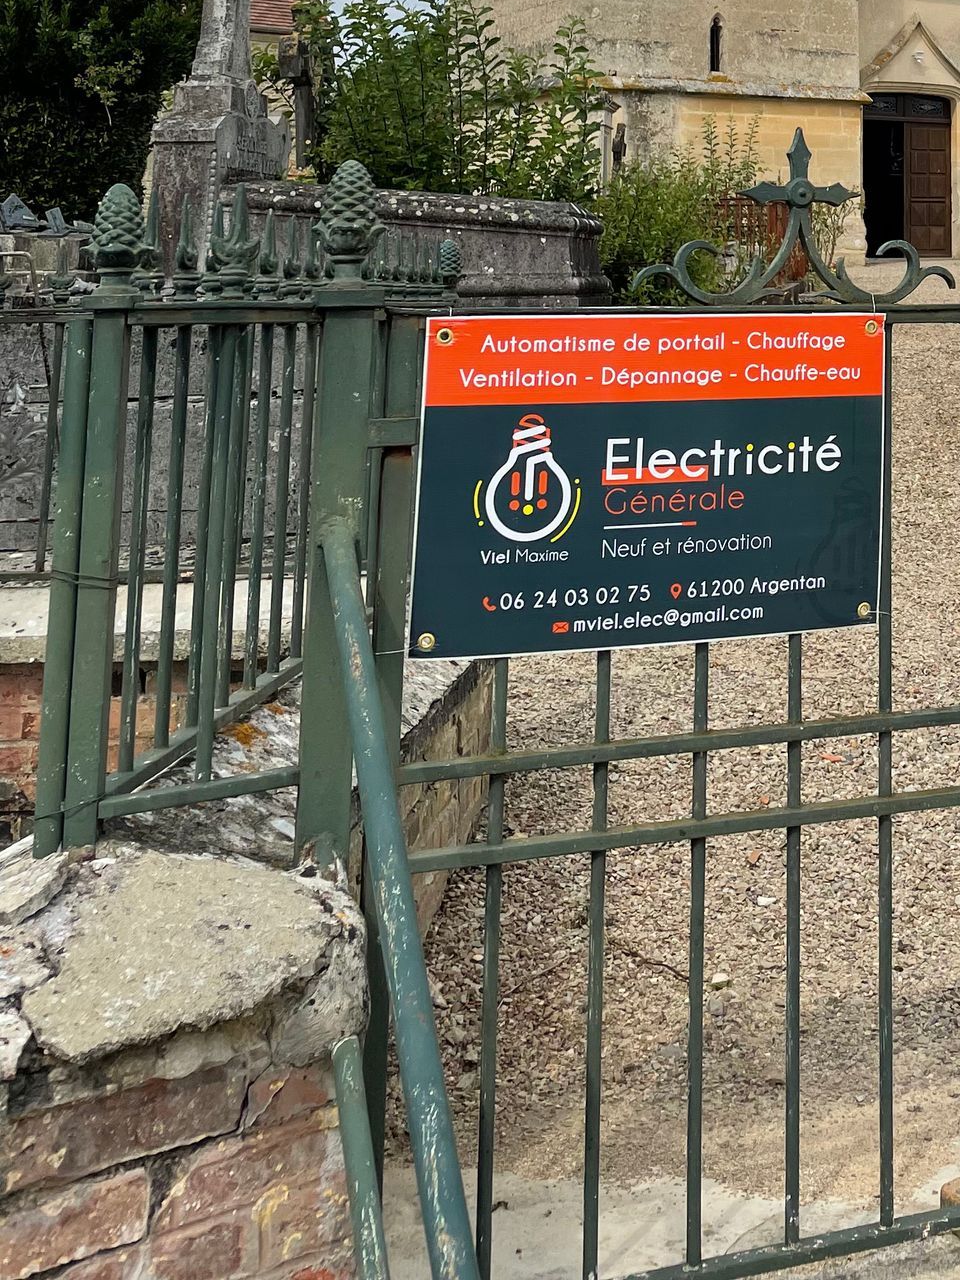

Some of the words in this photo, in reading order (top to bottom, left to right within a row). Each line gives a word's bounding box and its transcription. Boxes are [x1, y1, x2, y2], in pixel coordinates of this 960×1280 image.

[480, 334, 616, 353] Automatisme
[623, 333, 651, 352] de
[658, 332, 725, 354] portail
[747, 331, 846, 351] Chauffage
[459, 367, 577, 388] Ventilation
[601, 366, 723, 388] Dépannage
[744, 363, 861, 382] Chauffe-eau
[604, 436, 842, 480] Electricité
[604, 488, 745, 514] Générale
[480, 549, 511, 565] Viel
[515, 548, 569, 563] Maxime
[601, 537, 647, 559] Neuf
[652, 537, 672, 556] et
[677, 533, 772, 554] rénovation
[499, 591, 525, 611] 06
[533, 588, 558, 609] 24
[564, 588, 589, 607] 03
[595, 586, 620, 605] 02
[627, 584, 651, 603] 75
[687, 578, 745, 599] 61200
[749, 575, 826, 595] Argentan
[573, 605, 764, 632] mviel.elec@gmail.com
